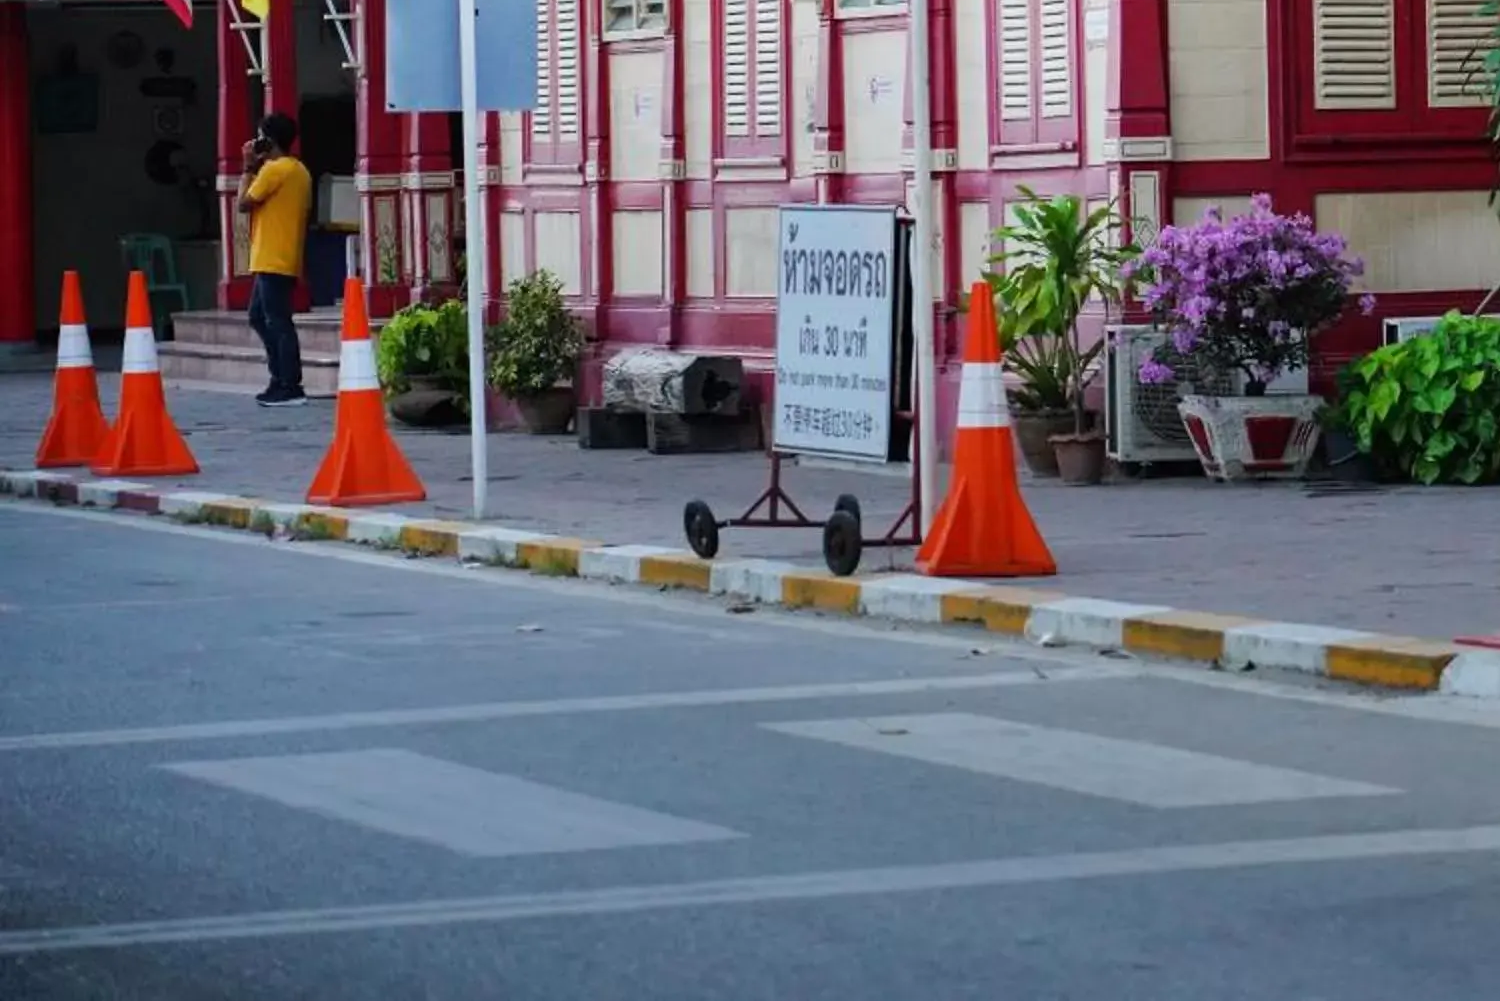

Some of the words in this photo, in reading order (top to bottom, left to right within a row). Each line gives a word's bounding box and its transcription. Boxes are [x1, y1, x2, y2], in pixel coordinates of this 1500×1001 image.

[783, 221, 887, 299] ห้ามจอดรถ
[799, 314, 820, 356] เกิน
[823, 324, 840, 358] 30
[842, 315, 868, 358] นาที
